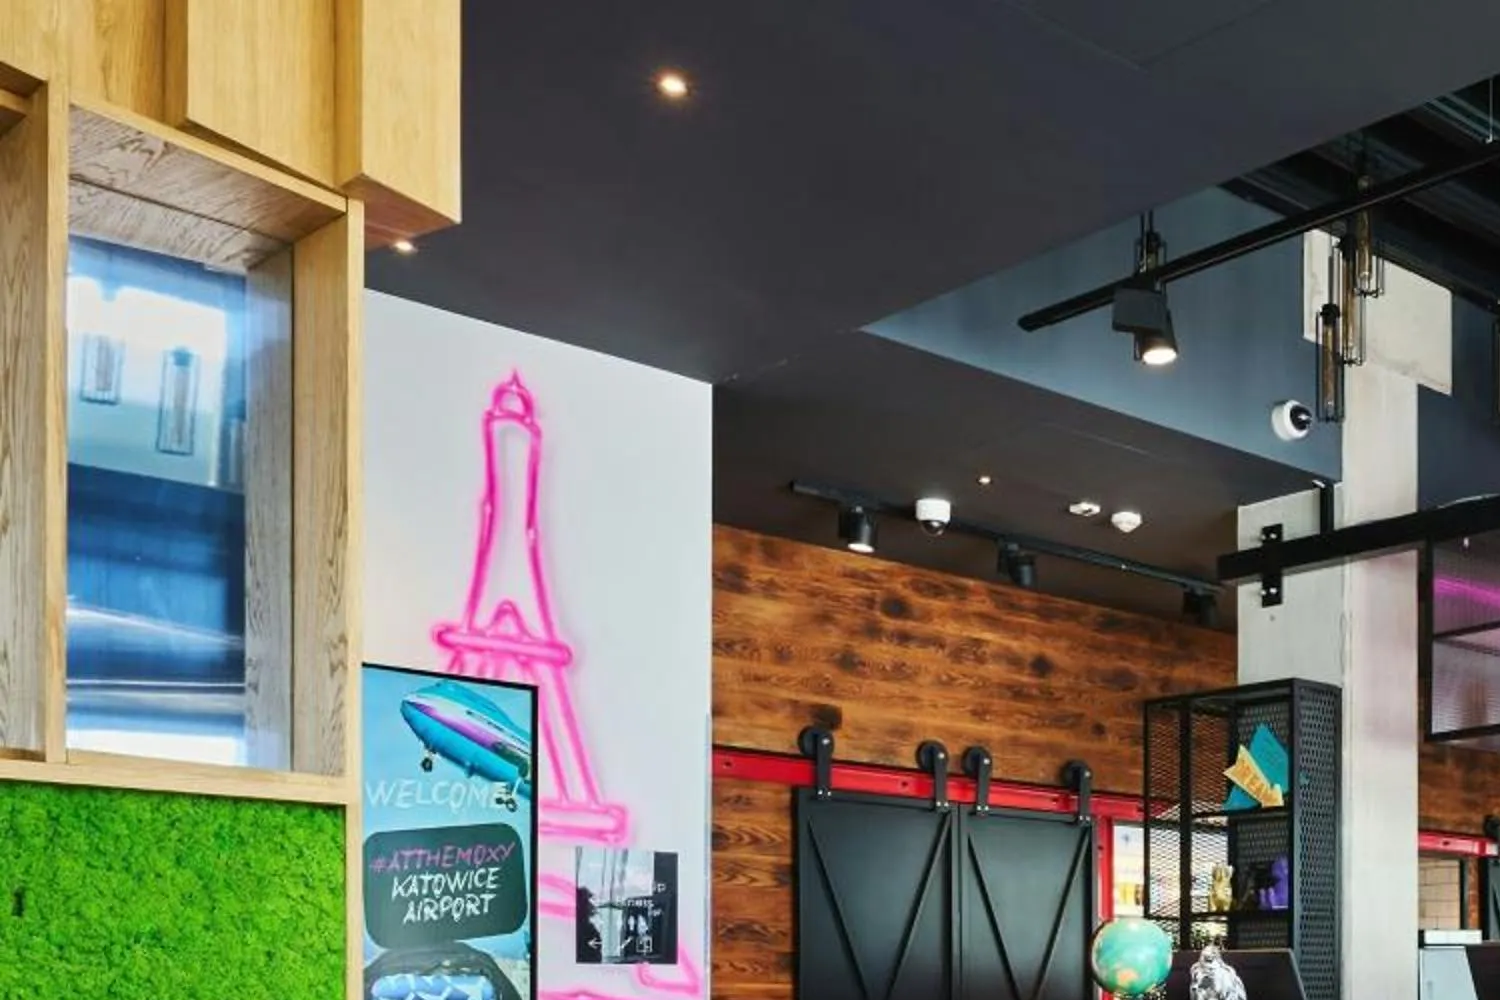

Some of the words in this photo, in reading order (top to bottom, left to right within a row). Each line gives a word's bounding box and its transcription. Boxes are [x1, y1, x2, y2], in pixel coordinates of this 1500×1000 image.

[369, 841, 516, 873] #ATTHEMOXY
[391, 867, 501, 900] KATOWICE
[403, 893, 496, 923] AIRPORT
